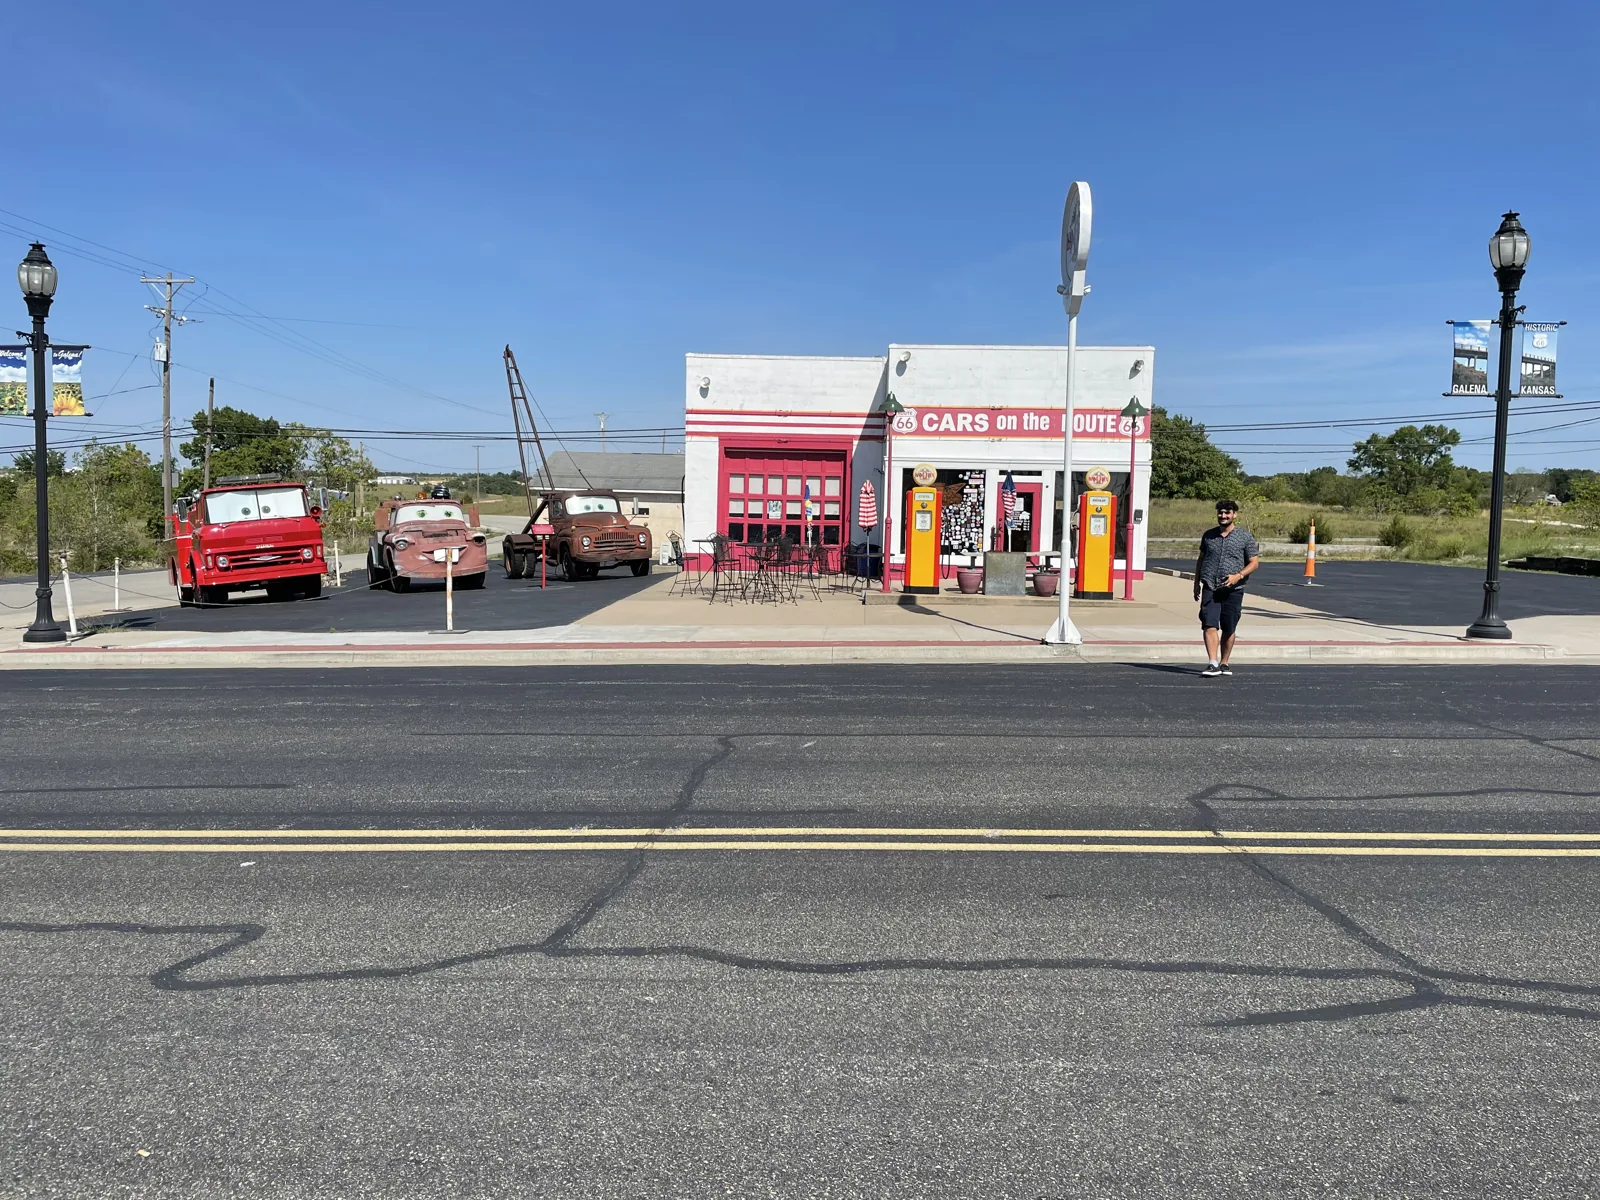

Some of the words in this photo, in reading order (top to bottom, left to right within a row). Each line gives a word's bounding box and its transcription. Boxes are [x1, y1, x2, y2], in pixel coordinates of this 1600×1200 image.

[1525, 323, 1558, 332] HISTORIC
[1453, 384, 1488, 394] GALENA
[1521, 385, 1555, 395] KANSAS
[896, 417, 913, 429] 66
[922, 413, 989, 432] CARS
[996, 415, 1017, 430] on
[1023, 412, 1050, 430] the
